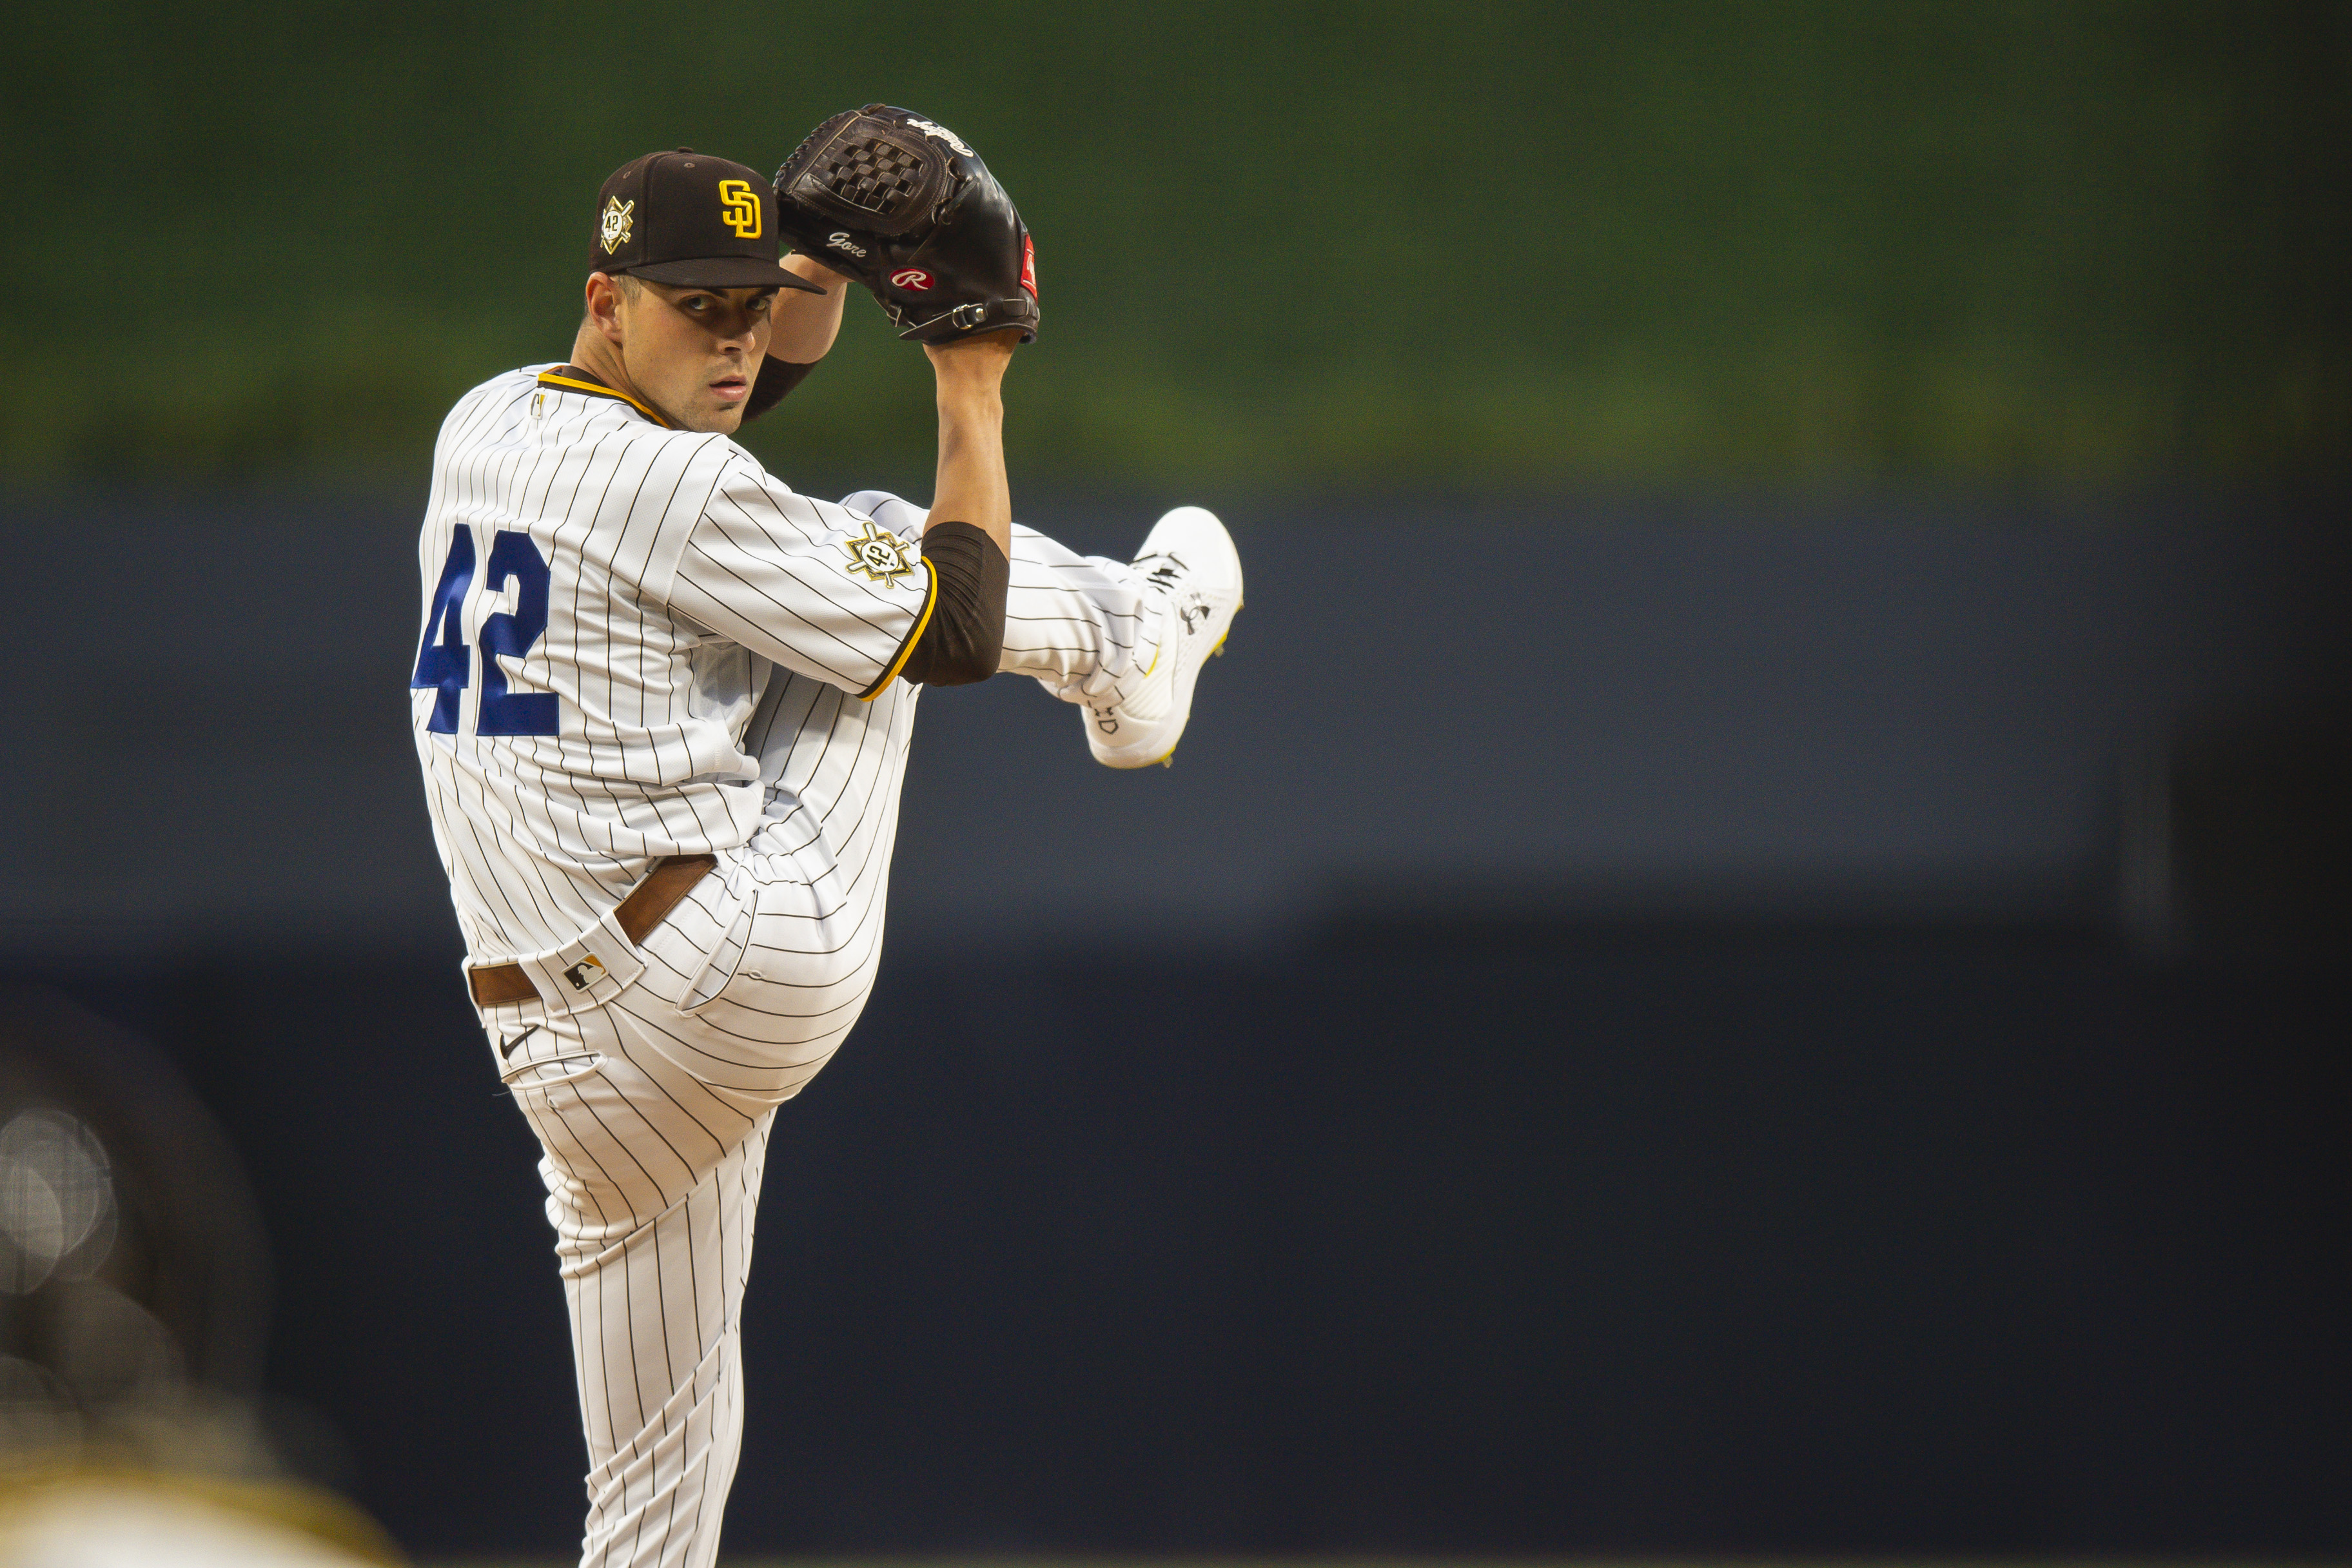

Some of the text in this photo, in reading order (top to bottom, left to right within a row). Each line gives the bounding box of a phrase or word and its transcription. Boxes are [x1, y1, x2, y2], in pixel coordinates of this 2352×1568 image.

[719, 179, 762, 239] SD
[604, 215, 619, 232] 42
[826, 231, 867, 258] Gore
[866, 545, 891, 567] 42
[410, 523, 559, 736] 42
